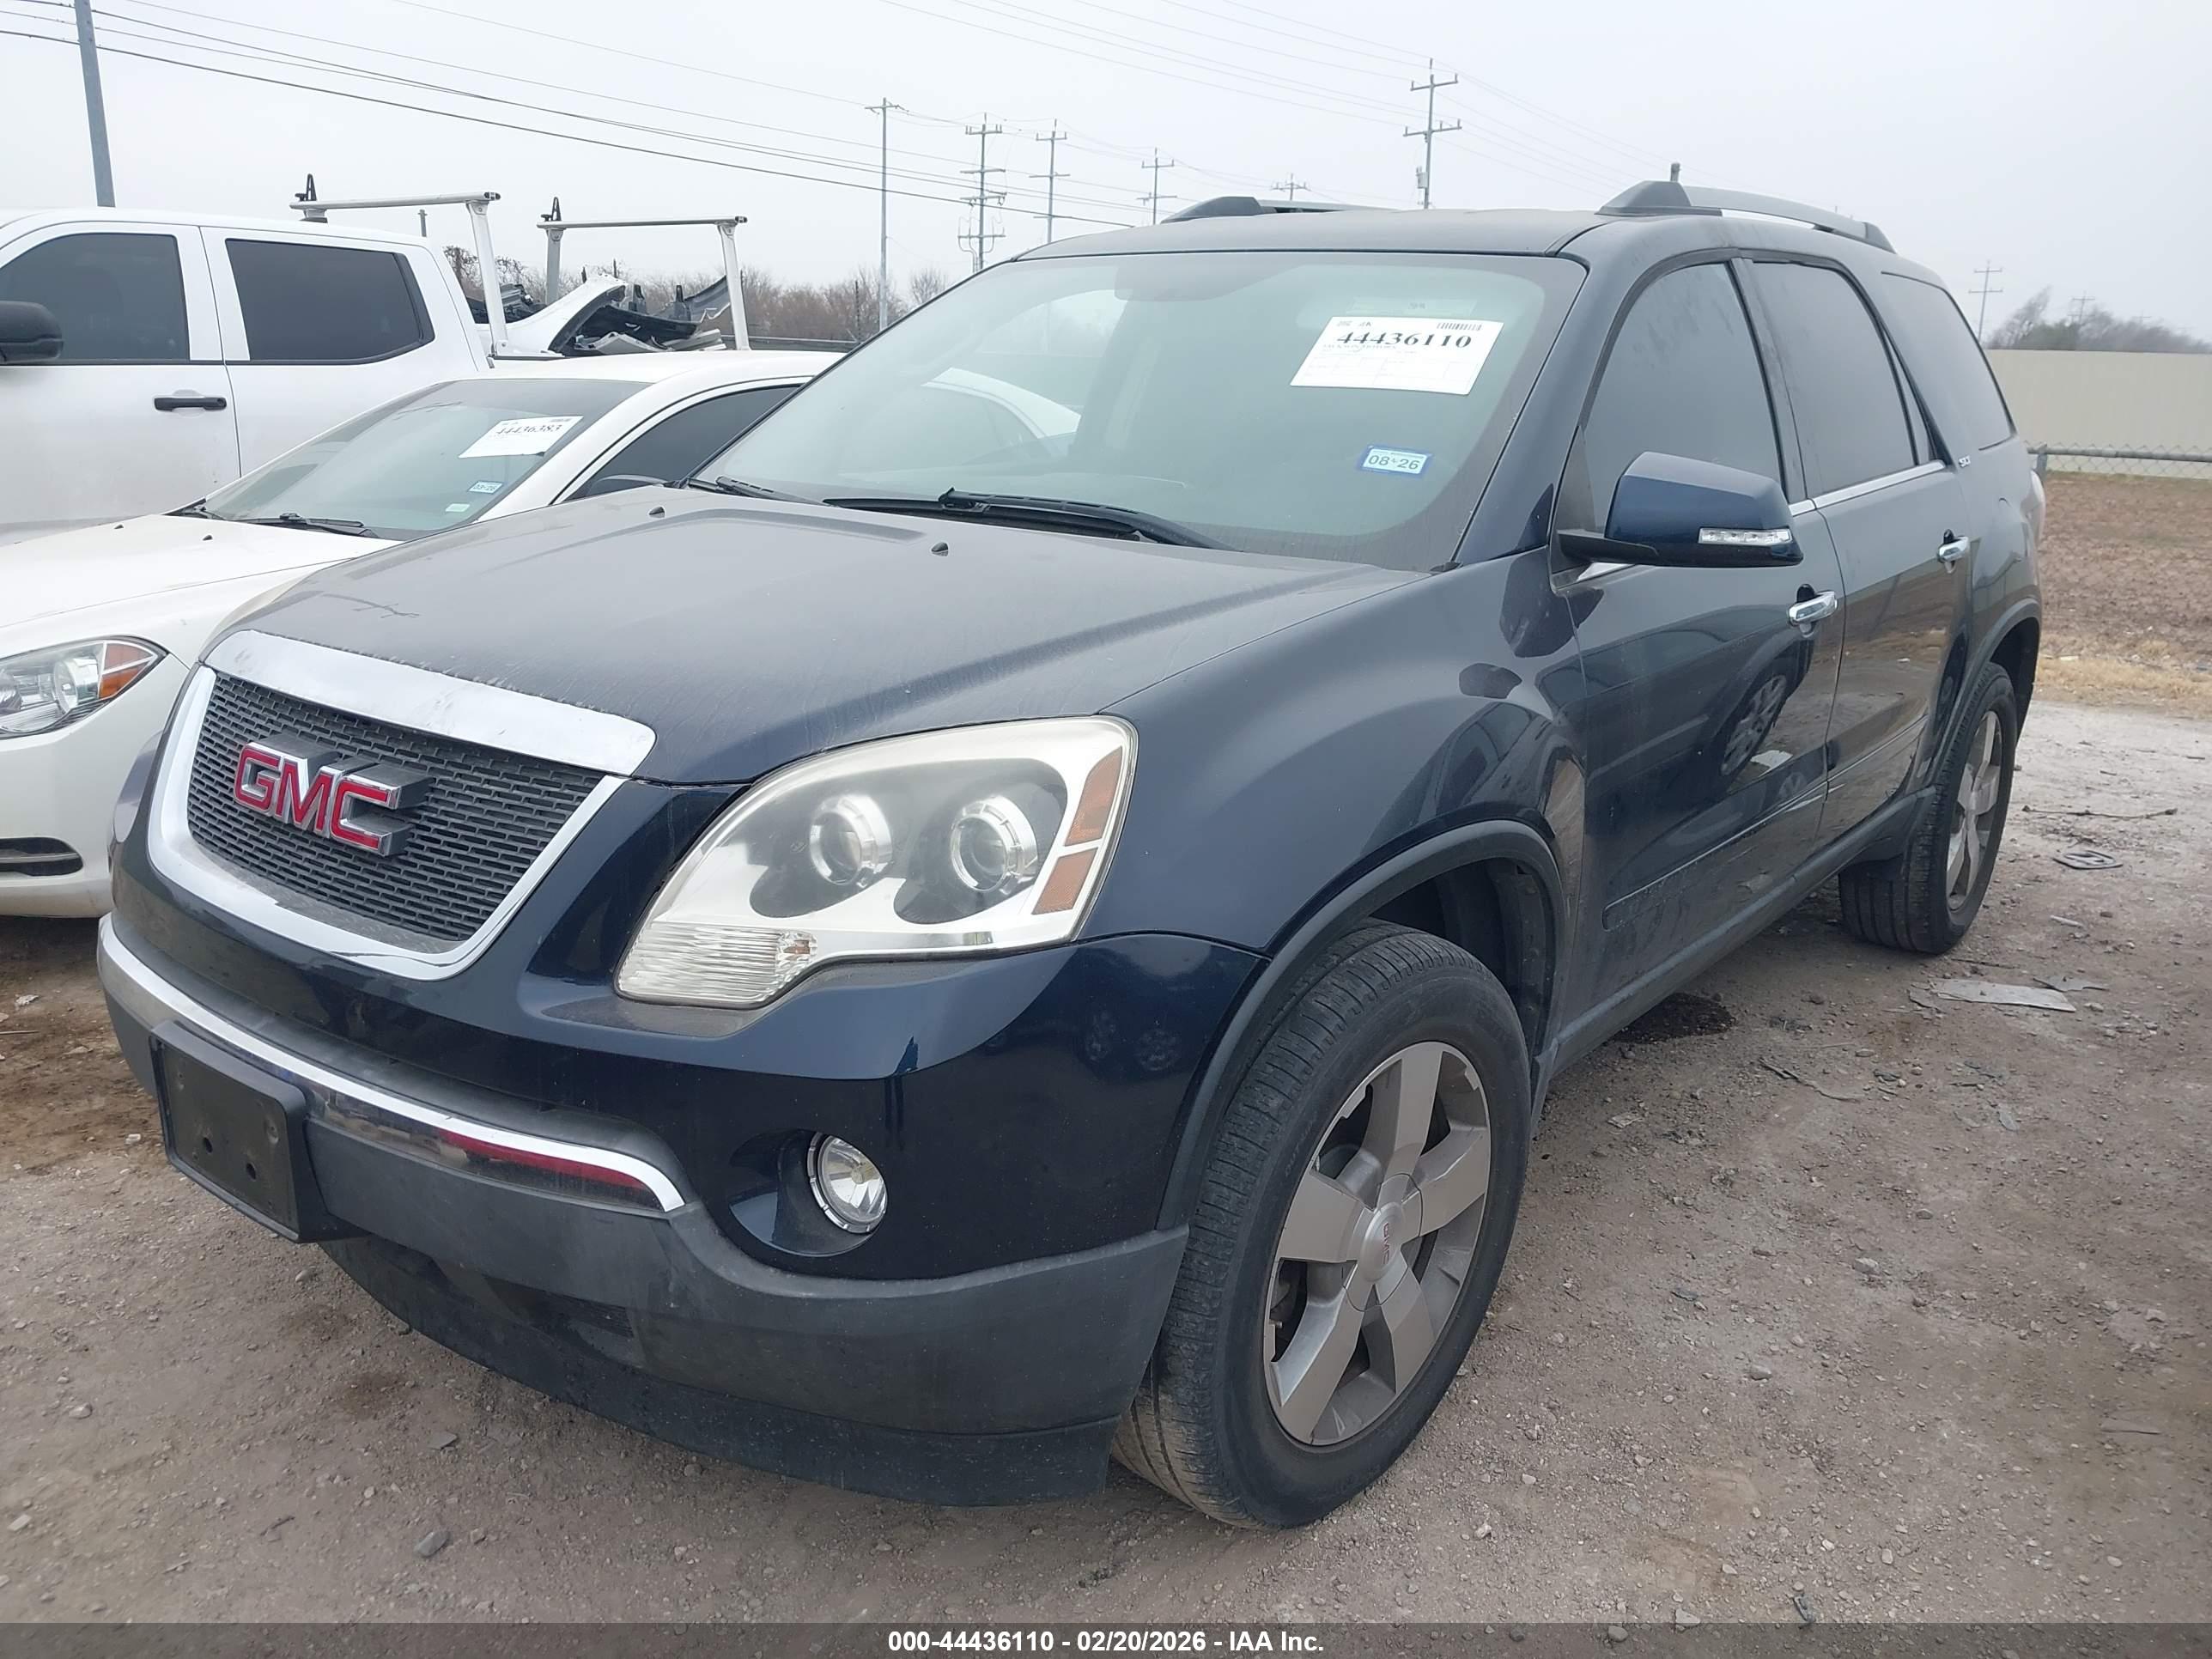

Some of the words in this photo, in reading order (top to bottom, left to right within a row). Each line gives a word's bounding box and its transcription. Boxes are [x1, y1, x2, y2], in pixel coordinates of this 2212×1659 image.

[1336, 331, 1472, 349] 44436110
[495, 424, 563, 434] 44436383
[234, 742, 400, 857] GMC
